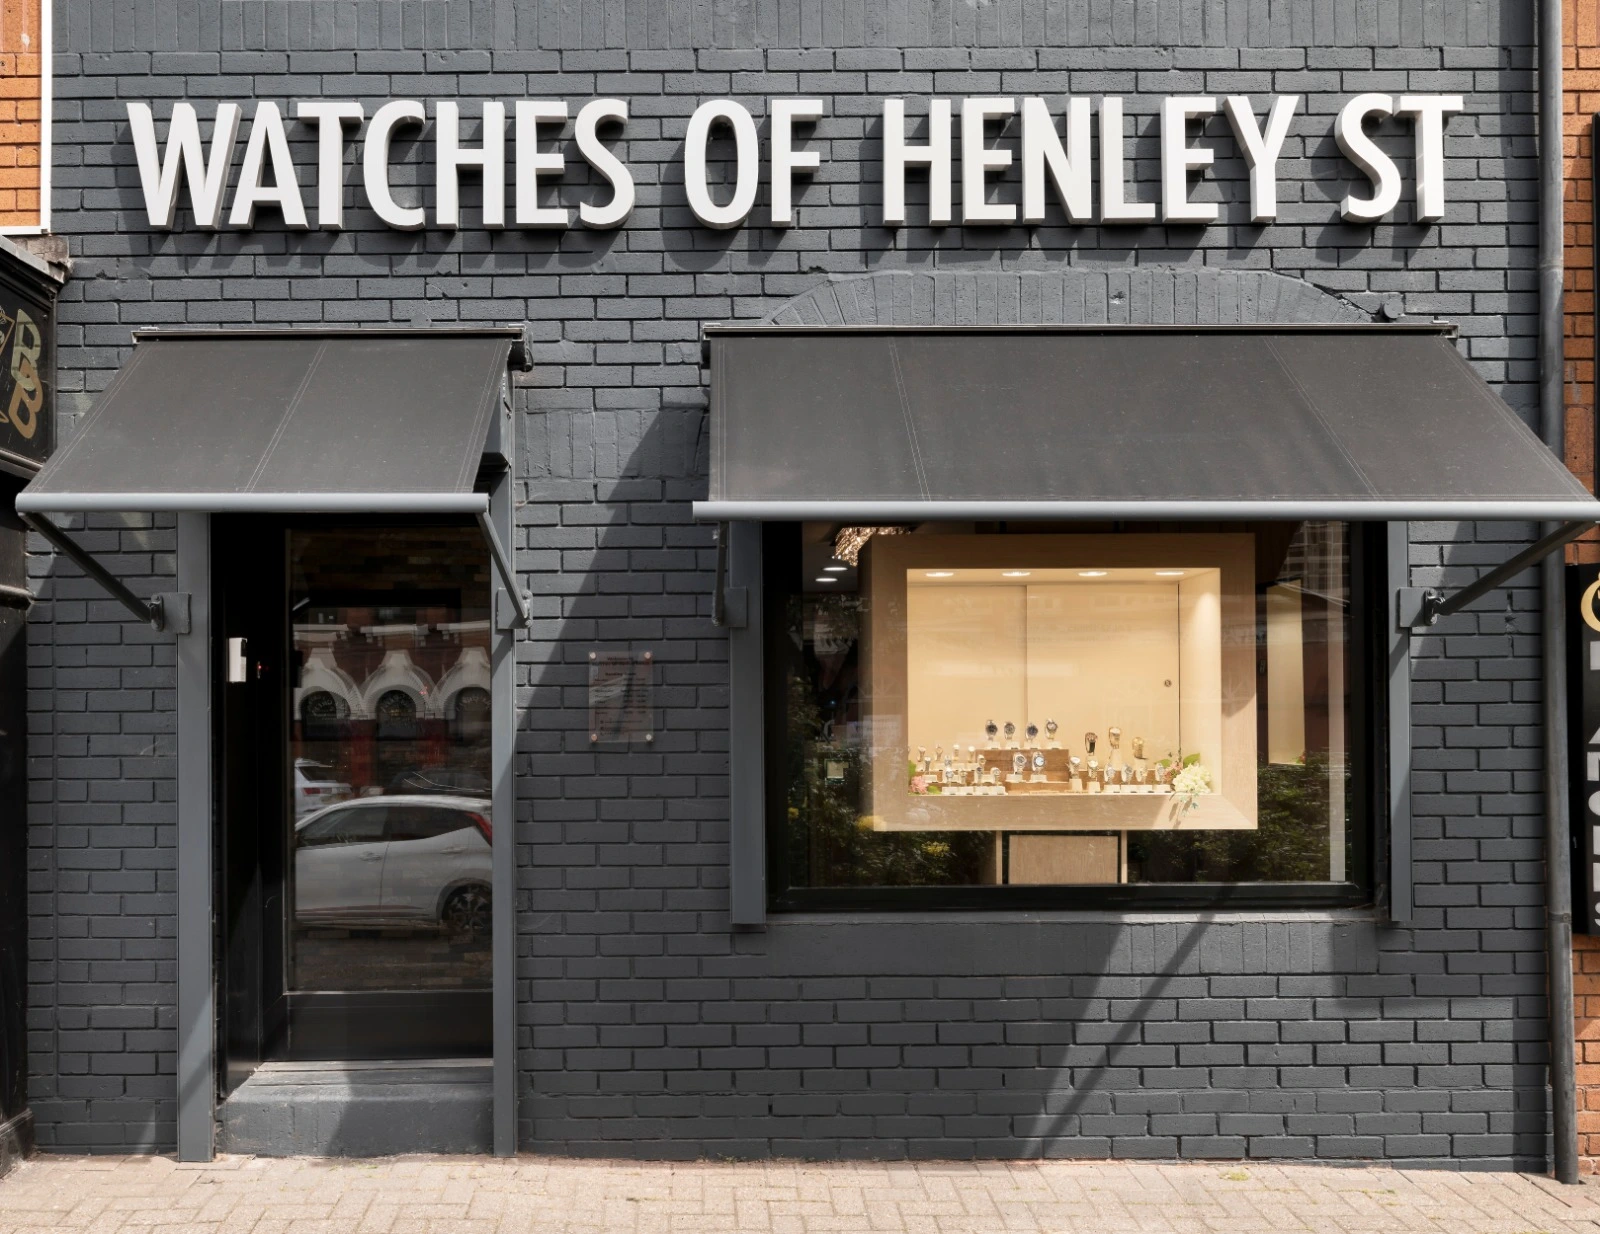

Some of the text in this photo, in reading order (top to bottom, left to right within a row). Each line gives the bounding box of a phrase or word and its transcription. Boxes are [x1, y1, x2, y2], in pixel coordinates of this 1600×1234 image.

[126, 92, 1465, 230] WATCHES OF HENLEY ST
